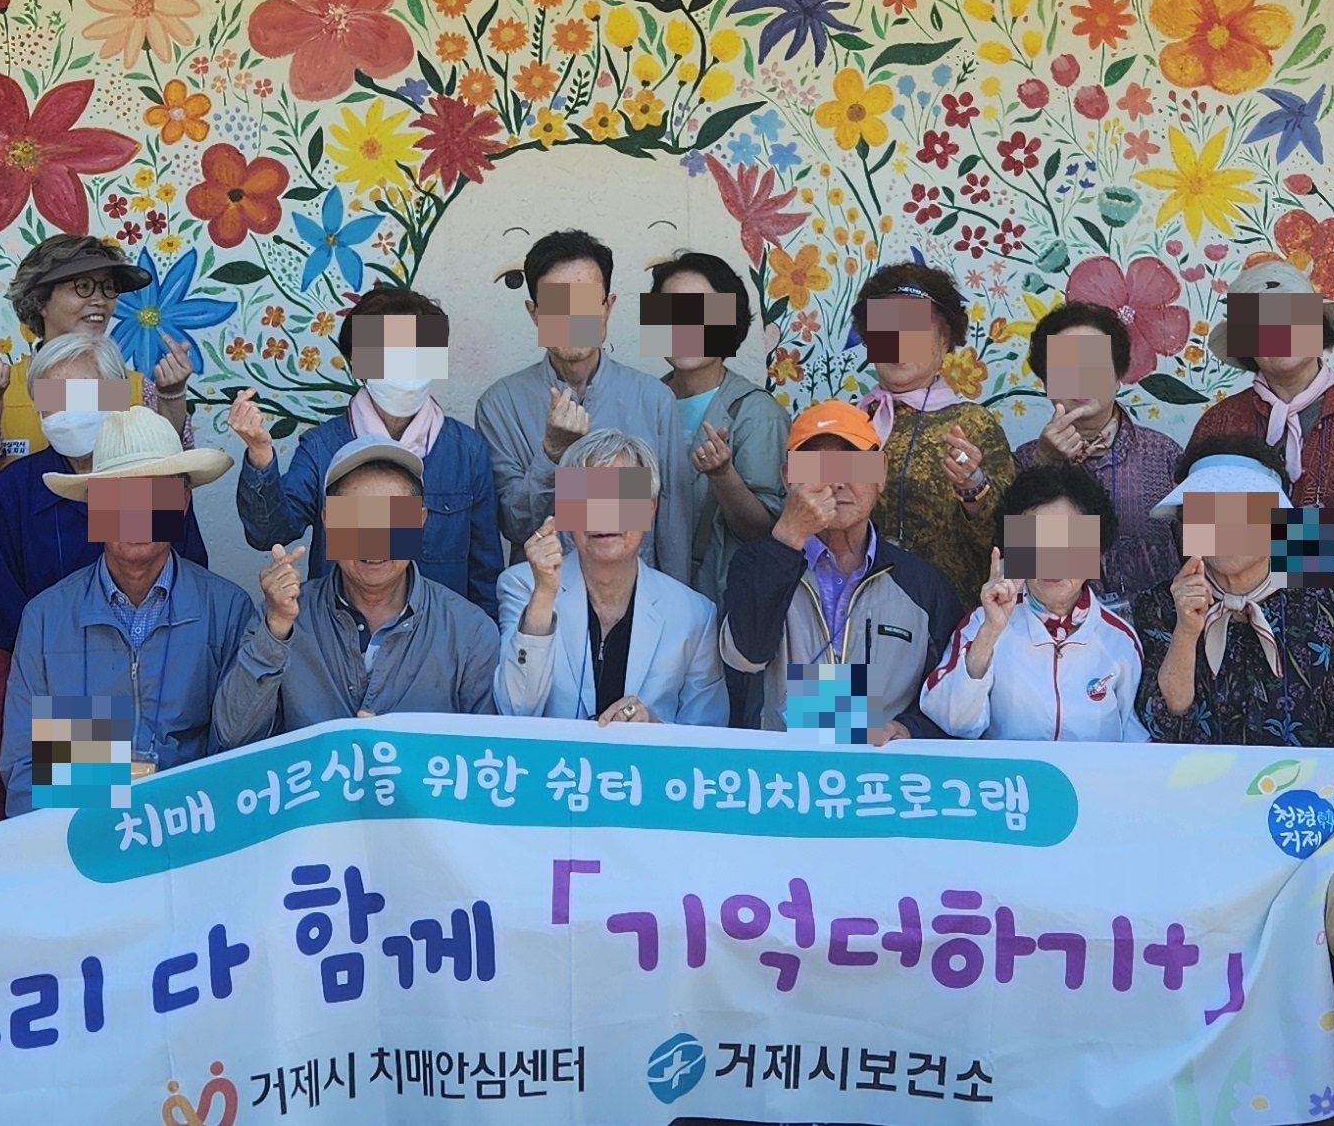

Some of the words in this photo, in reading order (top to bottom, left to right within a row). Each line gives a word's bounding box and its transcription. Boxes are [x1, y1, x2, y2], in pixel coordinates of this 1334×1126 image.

[115, 791, 216, 850] 치매
[236, 741, 403, 816] 어르신을
[423, 749, 528, 808] 위한
[546, 756, 644, 812] 쉼터
[666, 770, 1031, 832] 야외치유프로그램
[1280, 829, 1323, 853] 거제
[152, 924, 250, 1014] 다
[283, 863, 496, 1004] 함께
[250, 1051, 357, 1115] 거제시
[369, 1046, 585, 1100] 치매안심센터
[715, 1042, 993, 1103] 거제시보건소
